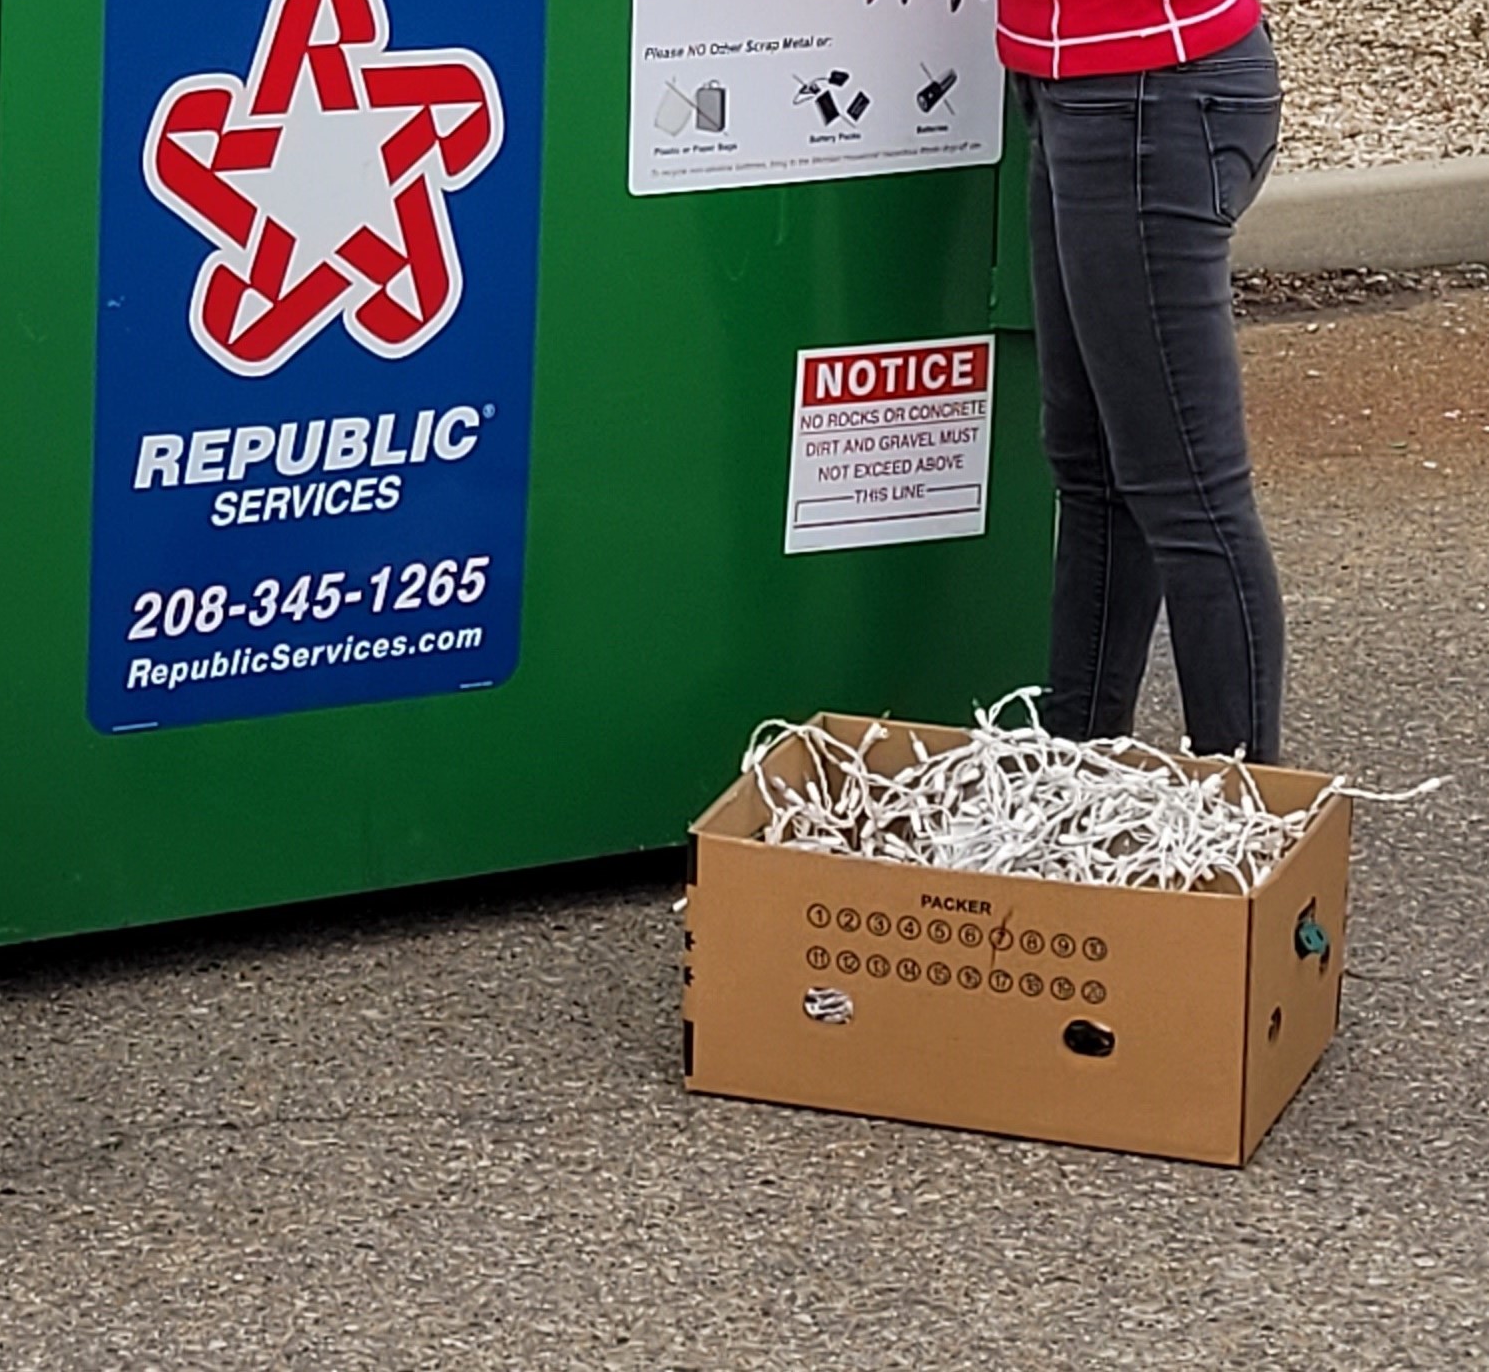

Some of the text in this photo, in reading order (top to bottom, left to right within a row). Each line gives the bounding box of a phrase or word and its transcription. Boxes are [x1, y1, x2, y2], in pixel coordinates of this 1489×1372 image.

[687, 43, 706, 57] NO
[816, 351, 974, 399] NOTICE
[800, 399, 987, 431] NO ROCKS OR CONCRETE
[133, 405, 480, 489] REPUBLIC
[806, 427, 979, 457] DIRT AND GRAVEL MUST
[818, 454, 964, 482] NOT EXCEED ABOVE
[210, 474, 402, 526] SERVICES
[854, 484, 926, 504] THIS LINE
[127, 555, 490, 641] 208-345-1265
[127, 627, 483, 689] RepublicServices.com
[921, 893, 992, 916] PACKER
